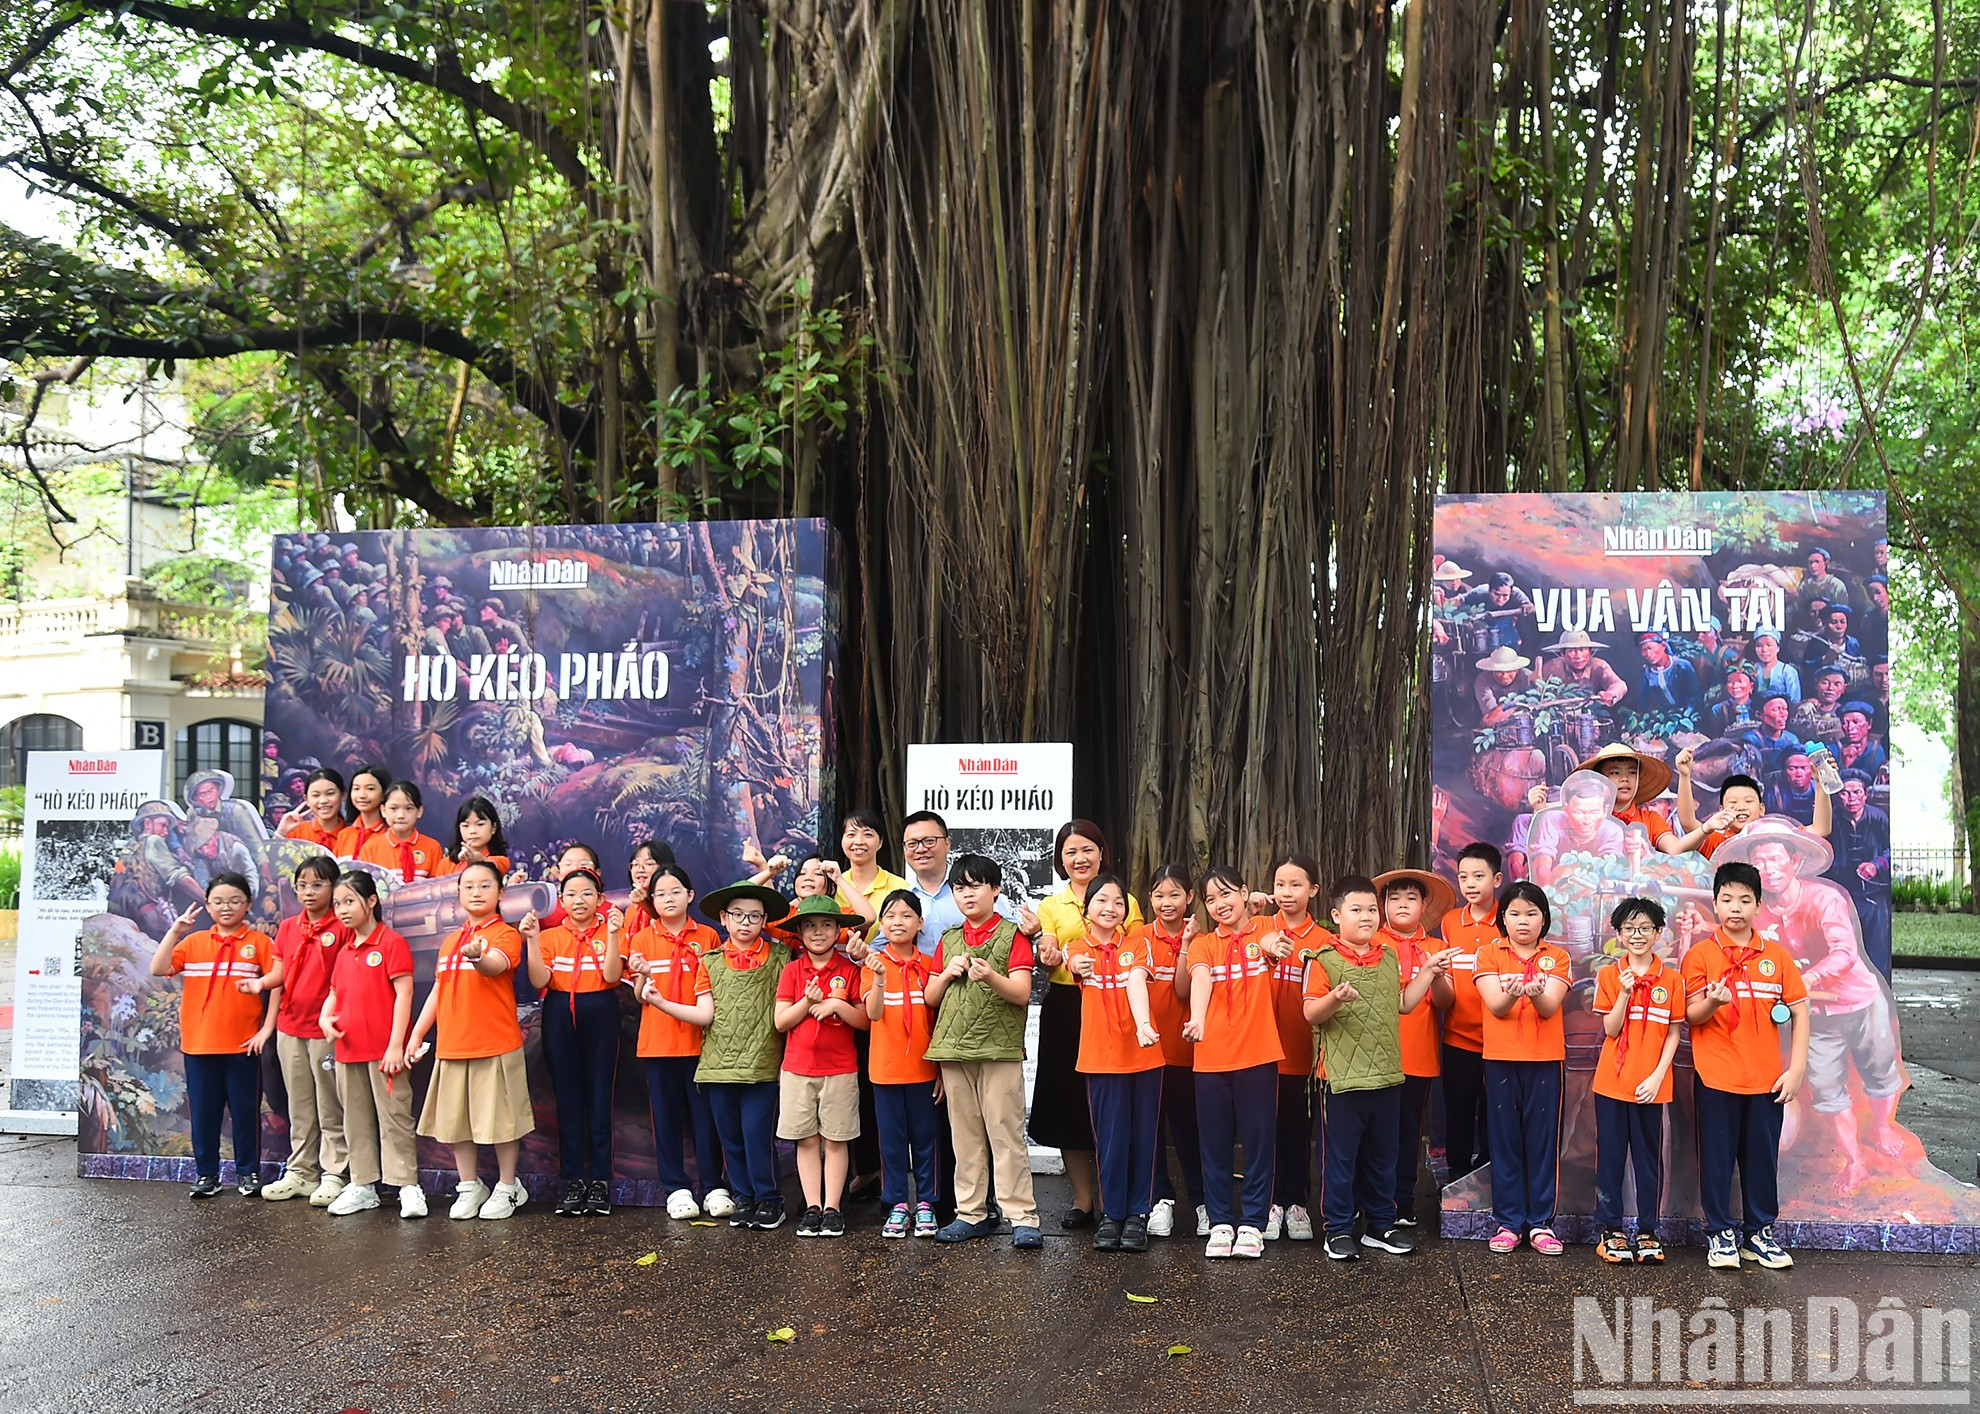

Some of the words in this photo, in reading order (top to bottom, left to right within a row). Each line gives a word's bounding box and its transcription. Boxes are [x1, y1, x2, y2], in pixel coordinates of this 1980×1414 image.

[1604, 525, 1664, 550] Nhân
[1666, 525, 1712, 550] Dân
[489, 559, 546, 584] Nhân
[546, 558, 588, 583] Dân
[1531, 588, 1615, 632] VUA
[1626, 578, 1711, 639] VẬN
[403, 645, 458, 702] HÒ
[469, 643, 547, 701] KÉO
[558, 642, 670, 701] PHÁO
[141, 724, 160, 745] B
[69, 759, 96, 771] Nhân
[96, 759, 117, 771] Dân
[959, 757, 991, 771] Nhân
[993, 757, 1018, 771] Dân
[35, 788, 62, 810] “HÒ
[67, 788, 95, 810] KÉO
[924, 784, 949, 810] HÒ
[957, 784, 993, 810] KÉO
[1001, 784, 1053, 810] PHÁO
